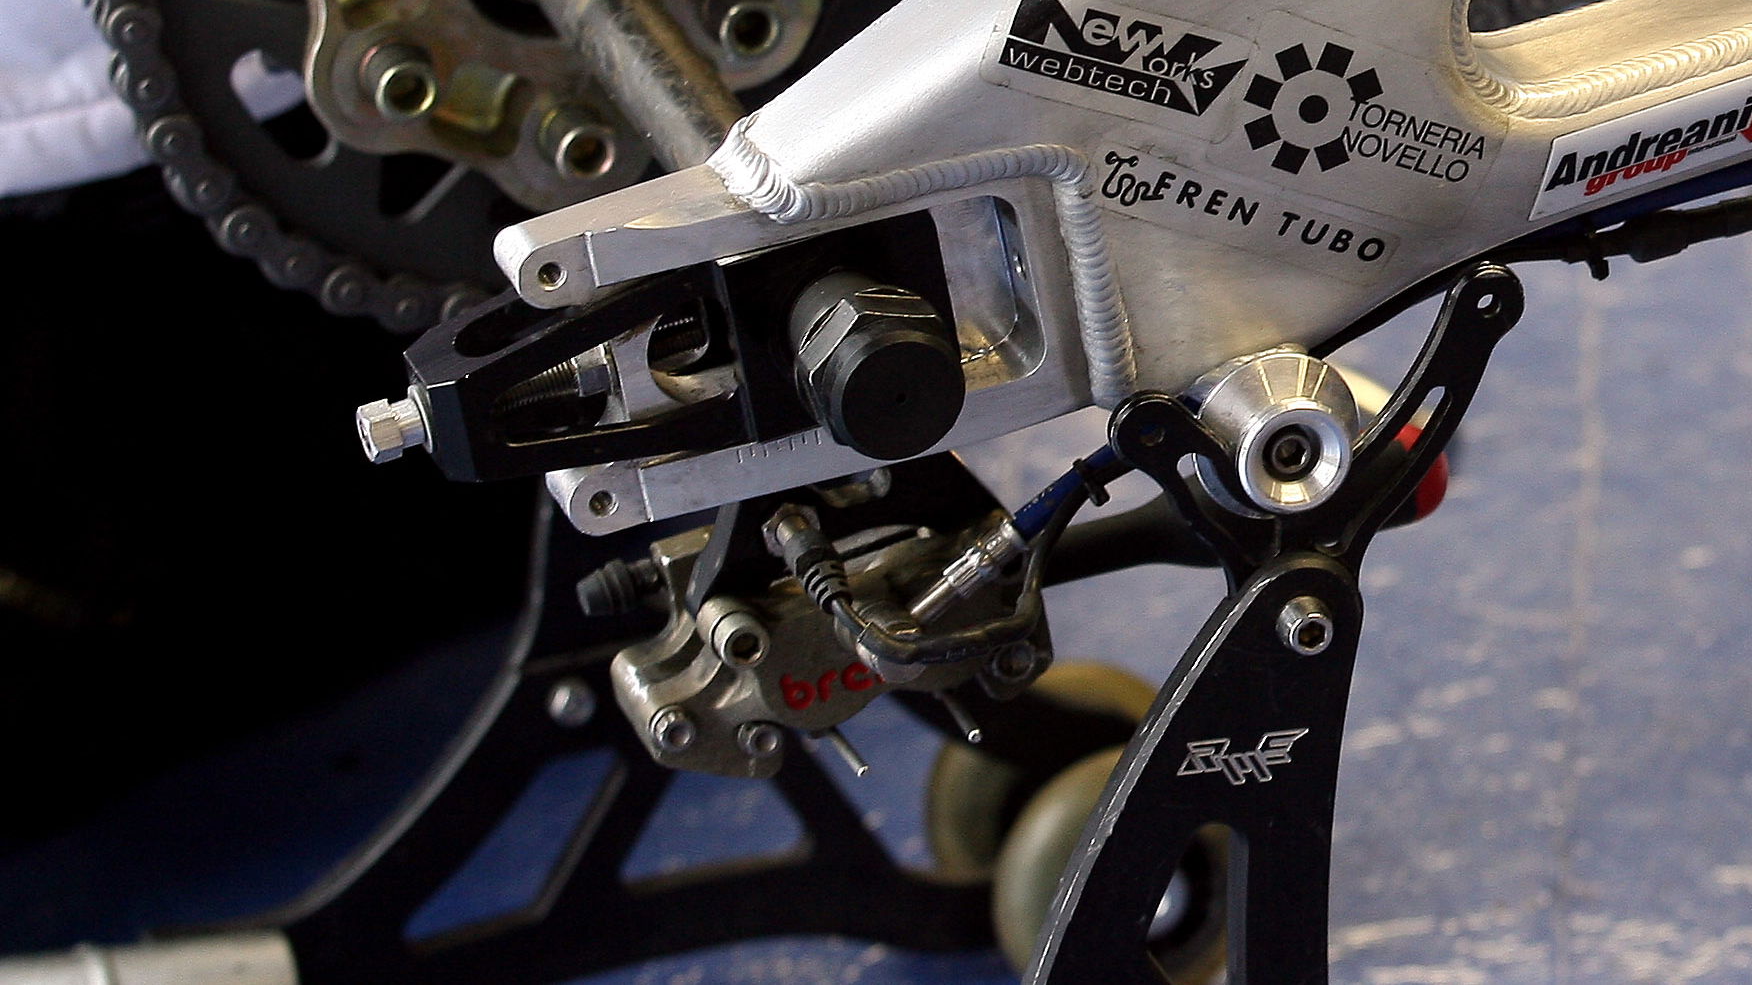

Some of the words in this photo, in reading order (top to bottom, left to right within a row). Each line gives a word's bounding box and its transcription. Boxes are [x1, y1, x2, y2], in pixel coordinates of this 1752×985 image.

[1009, 47, 1172, 105] webtech
[1337, 126, 1470, 182] NOVELLO
[1349, 96, 1485, 160] TORNERIA
[1583, 148, 1690, 196] group
[1277, 211, 1385, 262] TUBO
